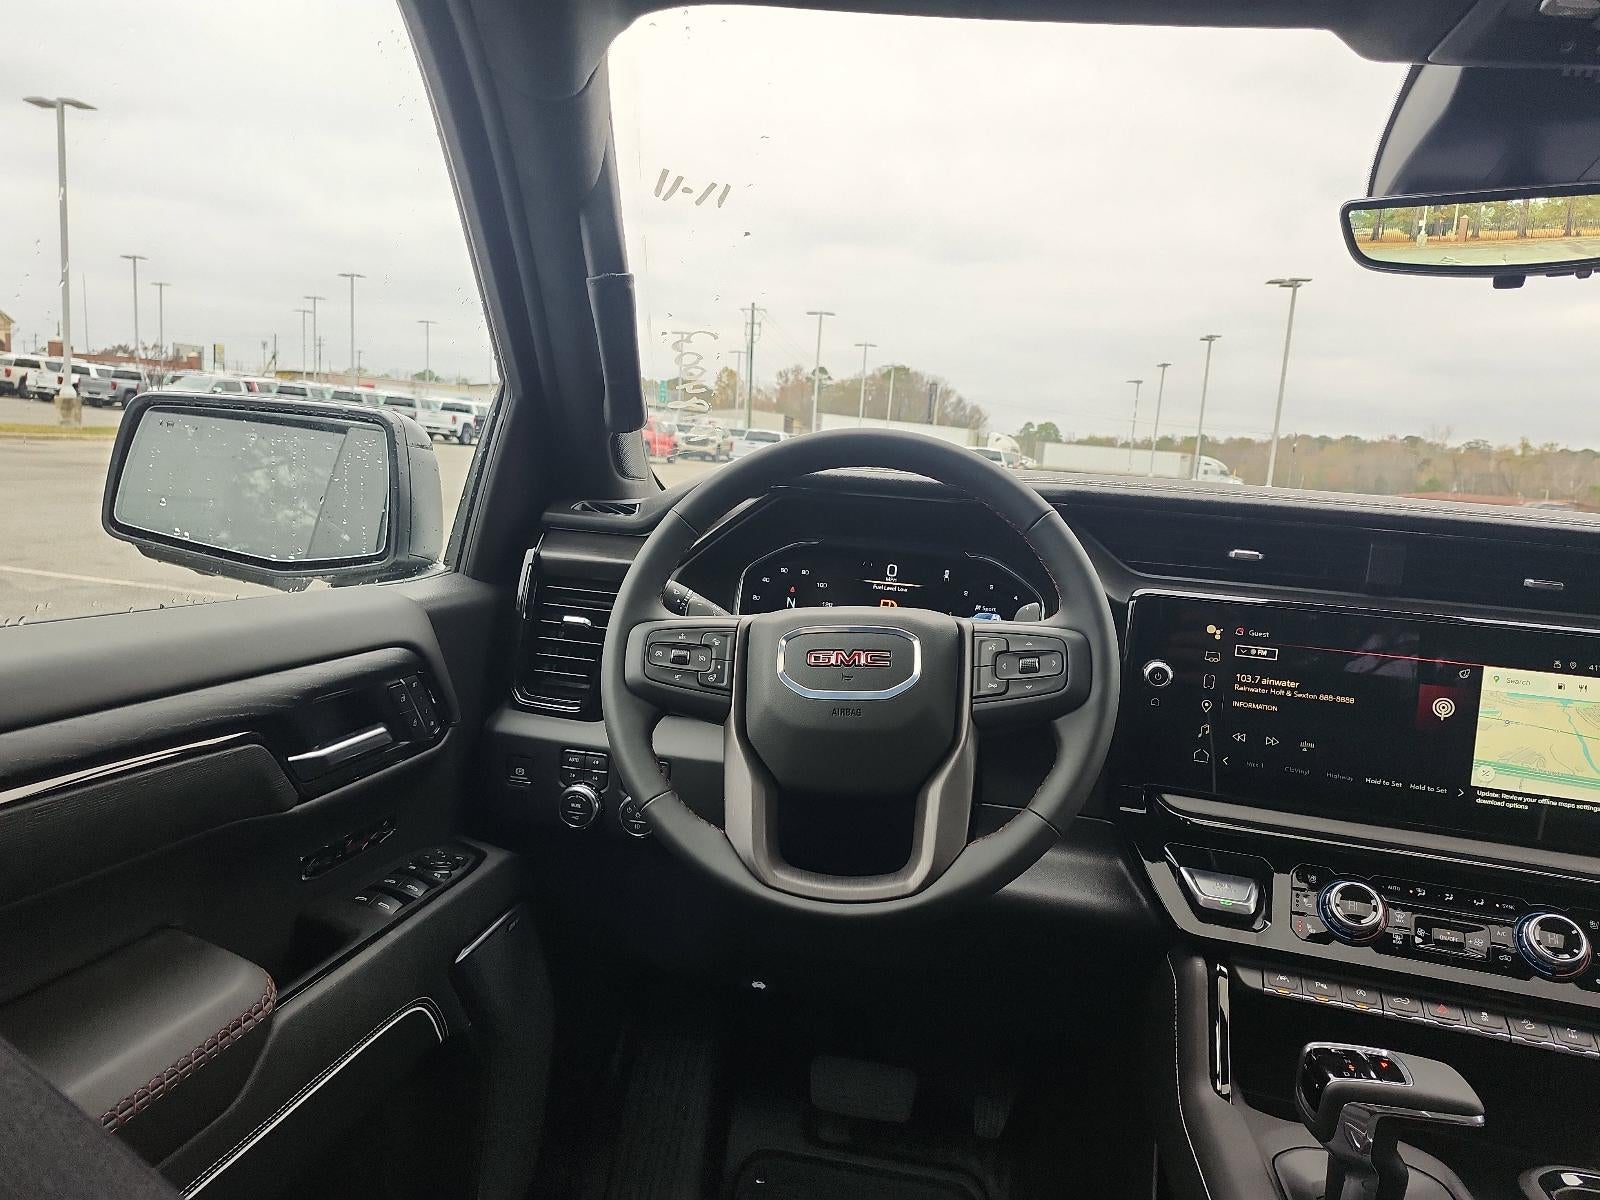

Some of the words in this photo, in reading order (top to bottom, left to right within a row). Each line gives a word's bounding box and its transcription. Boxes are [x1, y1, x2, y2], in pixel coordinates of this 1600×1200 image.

[1248, 629, 1270, 638] Guest
[806, 650, 892, 668] GMC
[1236, 673, 1260, 684] 103.7
[1261, 677, 1300, 689] ainwater
[1506, 678, 1531, 687] Search
[1234, 684, 1269, 694] Rainwater
[1270, 688, 1285, 696] Holt
[1293, 691, 1317, 700] Sexton
[1232, 701, 1278, 712] INFORMATION
[831, 707, 862, 717] AIRBAG
[1326, 772, 1353, 782] Highway
[1365, 777, 1381, 785] Hold
[1409, 783, 1426, 791] Hold
[1476, 798, 1505, 807] download
[1505, 801, 1529, 810] options
[1501, 792, 1523, 801] Review
[1523, 796, 1538, 804] your
[1538, 797, 1557, 806] offline
[1558, 801, 1575, 810] maps
